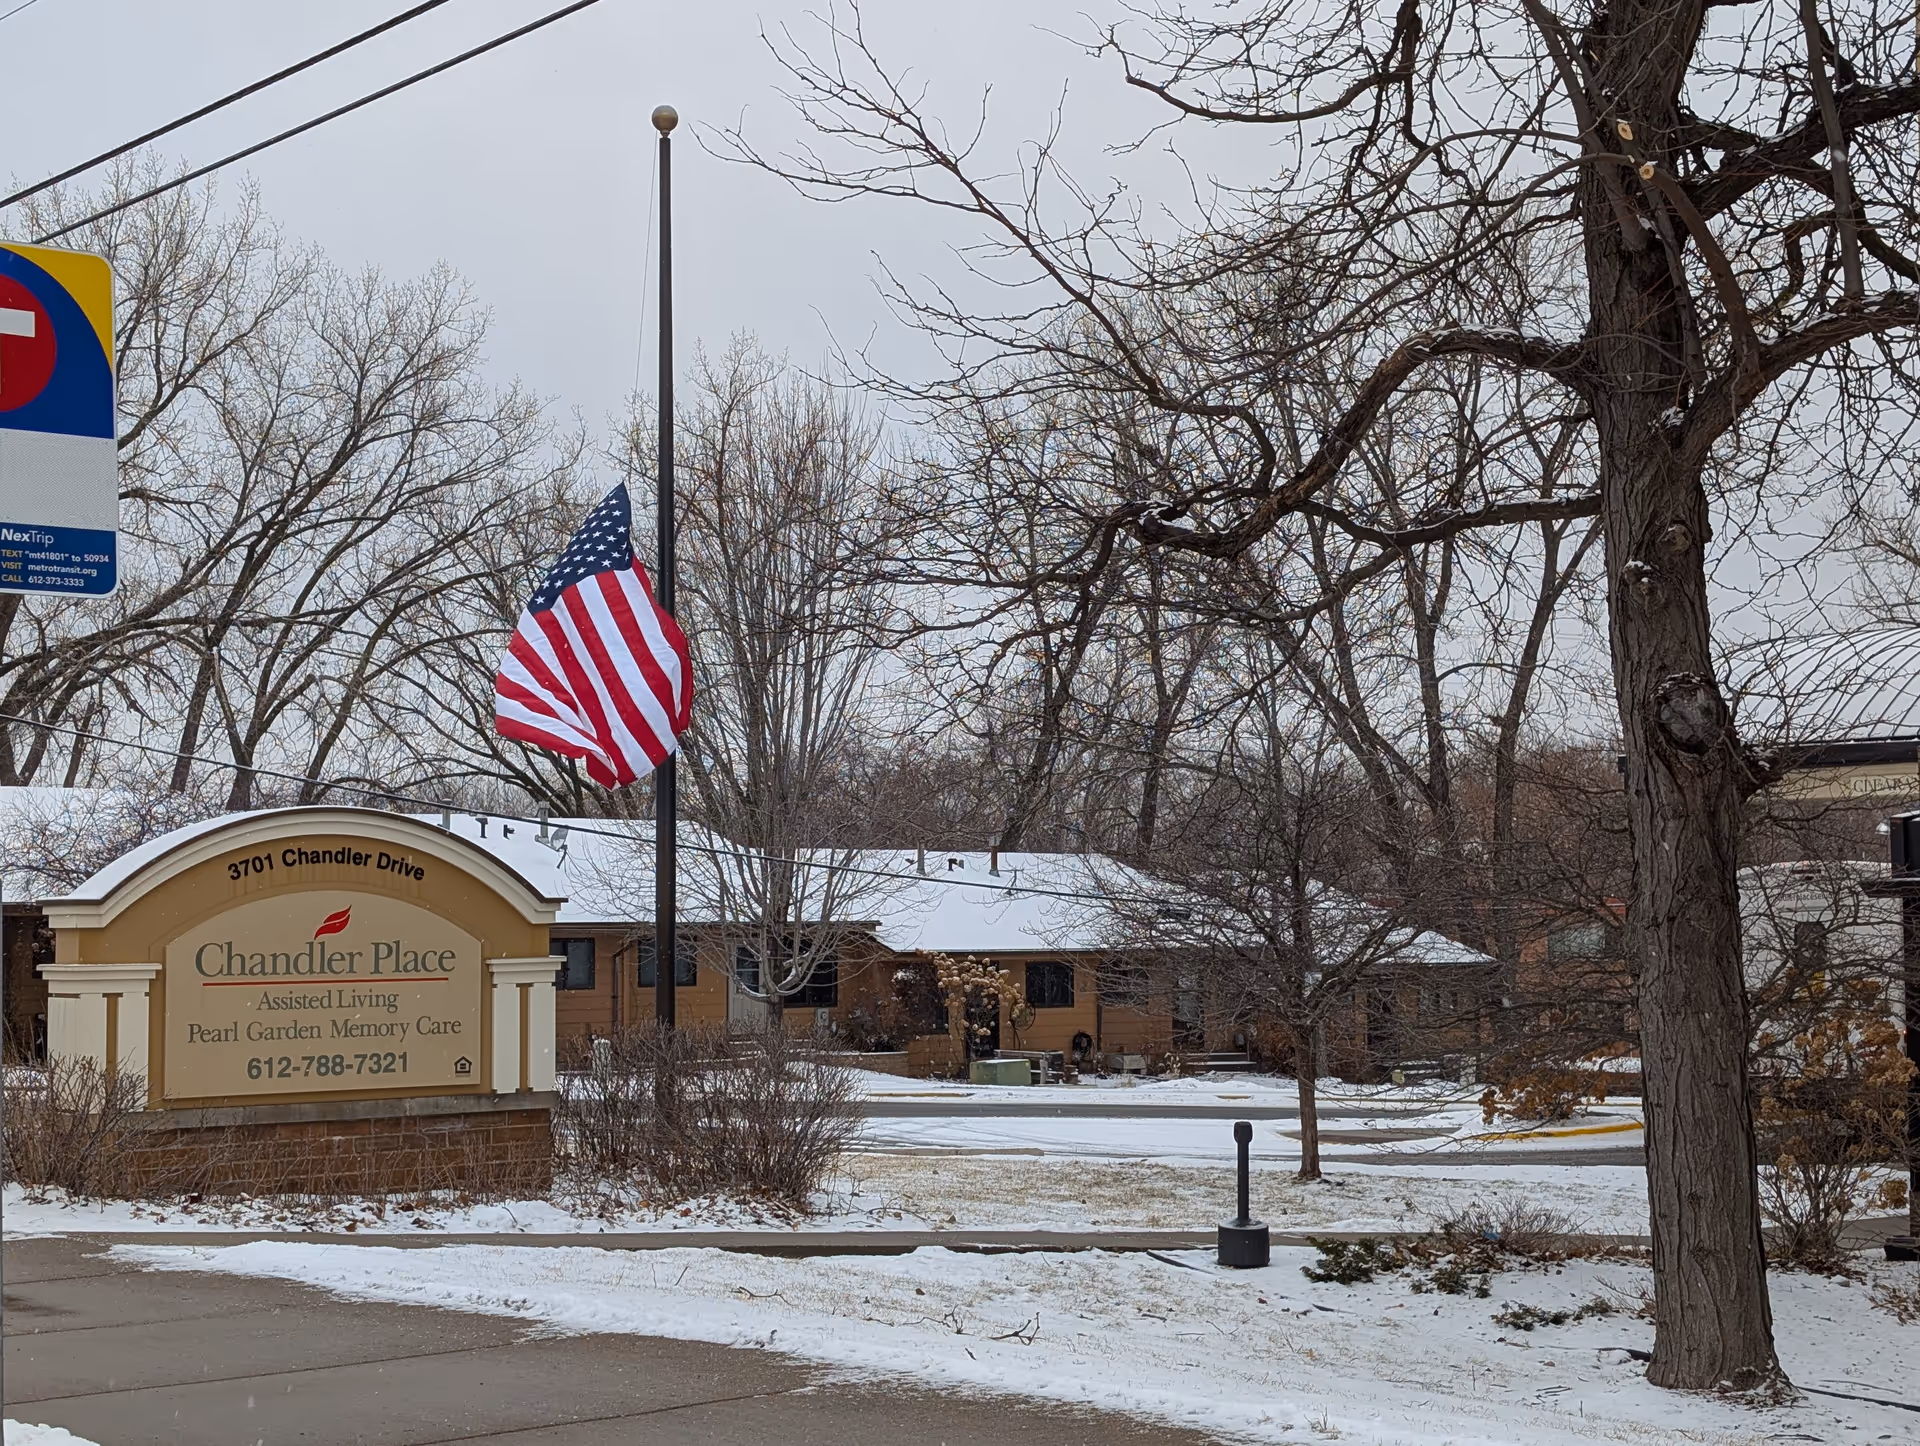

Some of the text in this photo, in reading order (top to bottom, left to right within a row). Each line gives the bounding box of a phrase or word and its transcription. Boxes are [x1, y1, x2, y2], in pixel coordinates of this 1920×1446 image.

[1, 528, 54, 548] NexTrip
[1, 549, 23, 558] TEXT
[71, 554, 81, 562] to
[84, 554, 109, 562] 50934
[1, 561, 97, 577] VISIT metrotransit.org
[1, 574, 84, 587] CALL 612-373-3333
[228, 847, 425, 880] 3701 Chandler Drive
[195, 940, 456, 977] Chandler Place
[256, 988, 399, 1014] Assisted Living
[187, 1016, 462, 1043] Pearl Garden Memory Care
[246, 1052, 408, 1080] 612-788-7321
